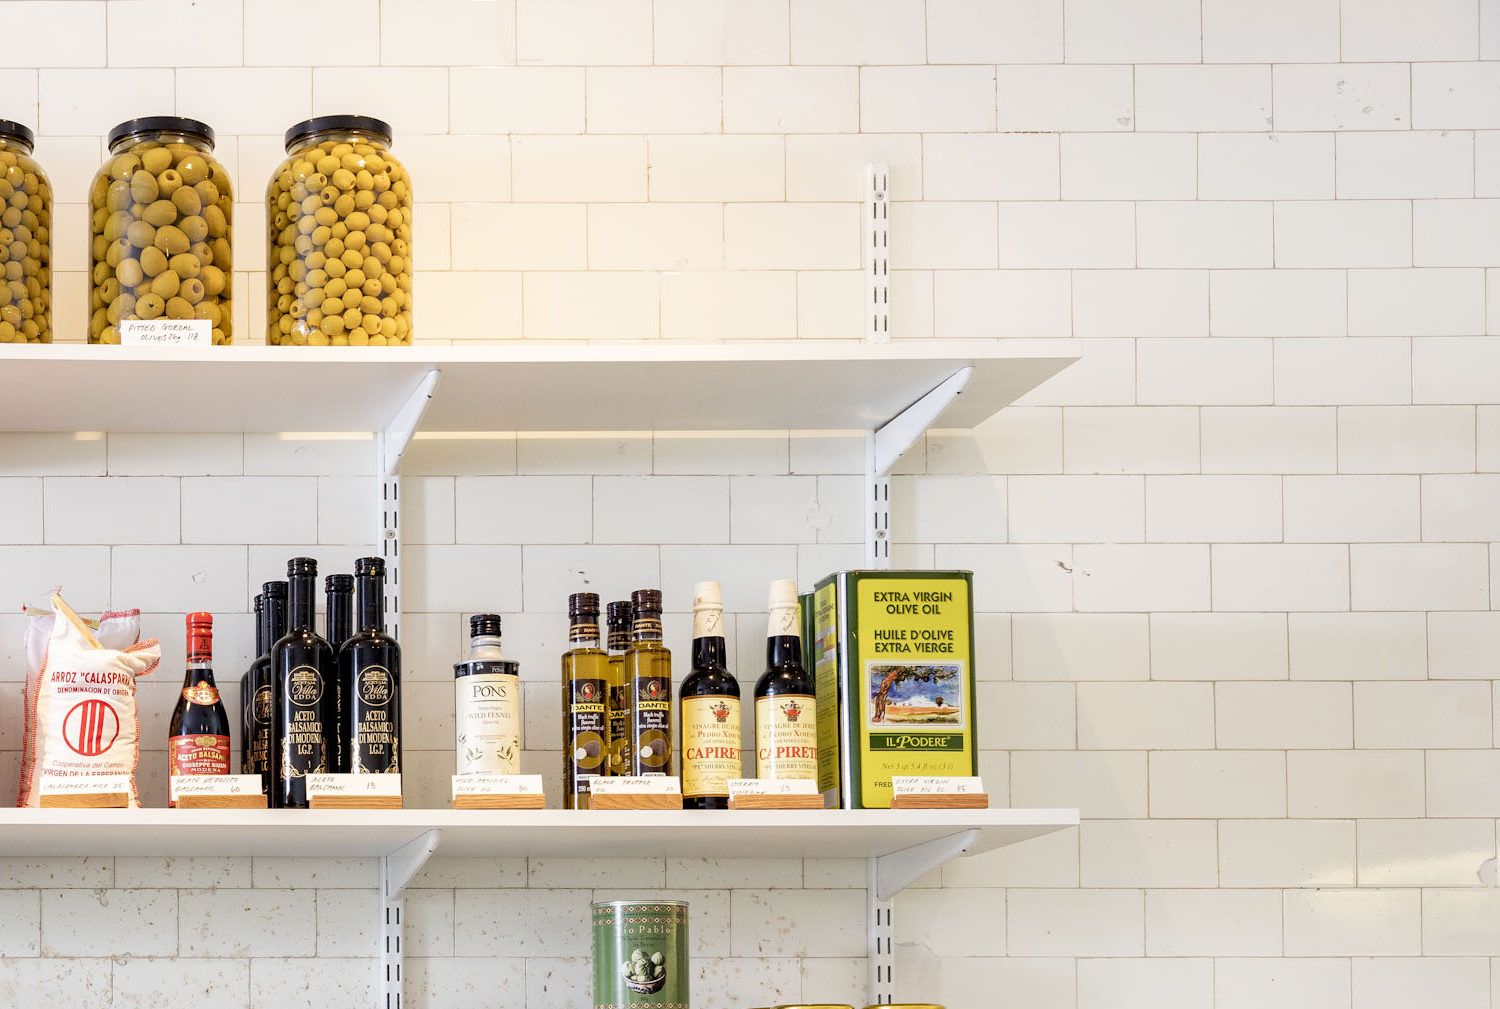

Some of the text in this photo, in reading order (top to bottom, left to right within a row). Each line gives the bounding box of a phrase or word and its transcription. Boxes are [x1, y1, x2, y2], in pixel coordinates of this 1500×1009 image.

[128, 324, 156, 332] PITTED
[873, 592, 953, 603] EXTRA VIRGIN
[886, 604, 942, 615] OLIVE OIL
[874, 630, 954, 641] HUILE D'OLIVE
[874, 642, 955, 654] EXTRA VIERGE
[51, 672, 77, 684] ARROZ
[290, 684, 317, 695] Villa
[362, 684, 389, 695] Villa
[472, 684, 508, 698] PONS
[294, 710, 316, 722] ACETO
[364, 710, 386, 722] ACETO
[896, 735, 948, 749] PODERE
[52, 760, 125, 770] Cooperativa Campo
[638, 925, 672, 934] Pablo
